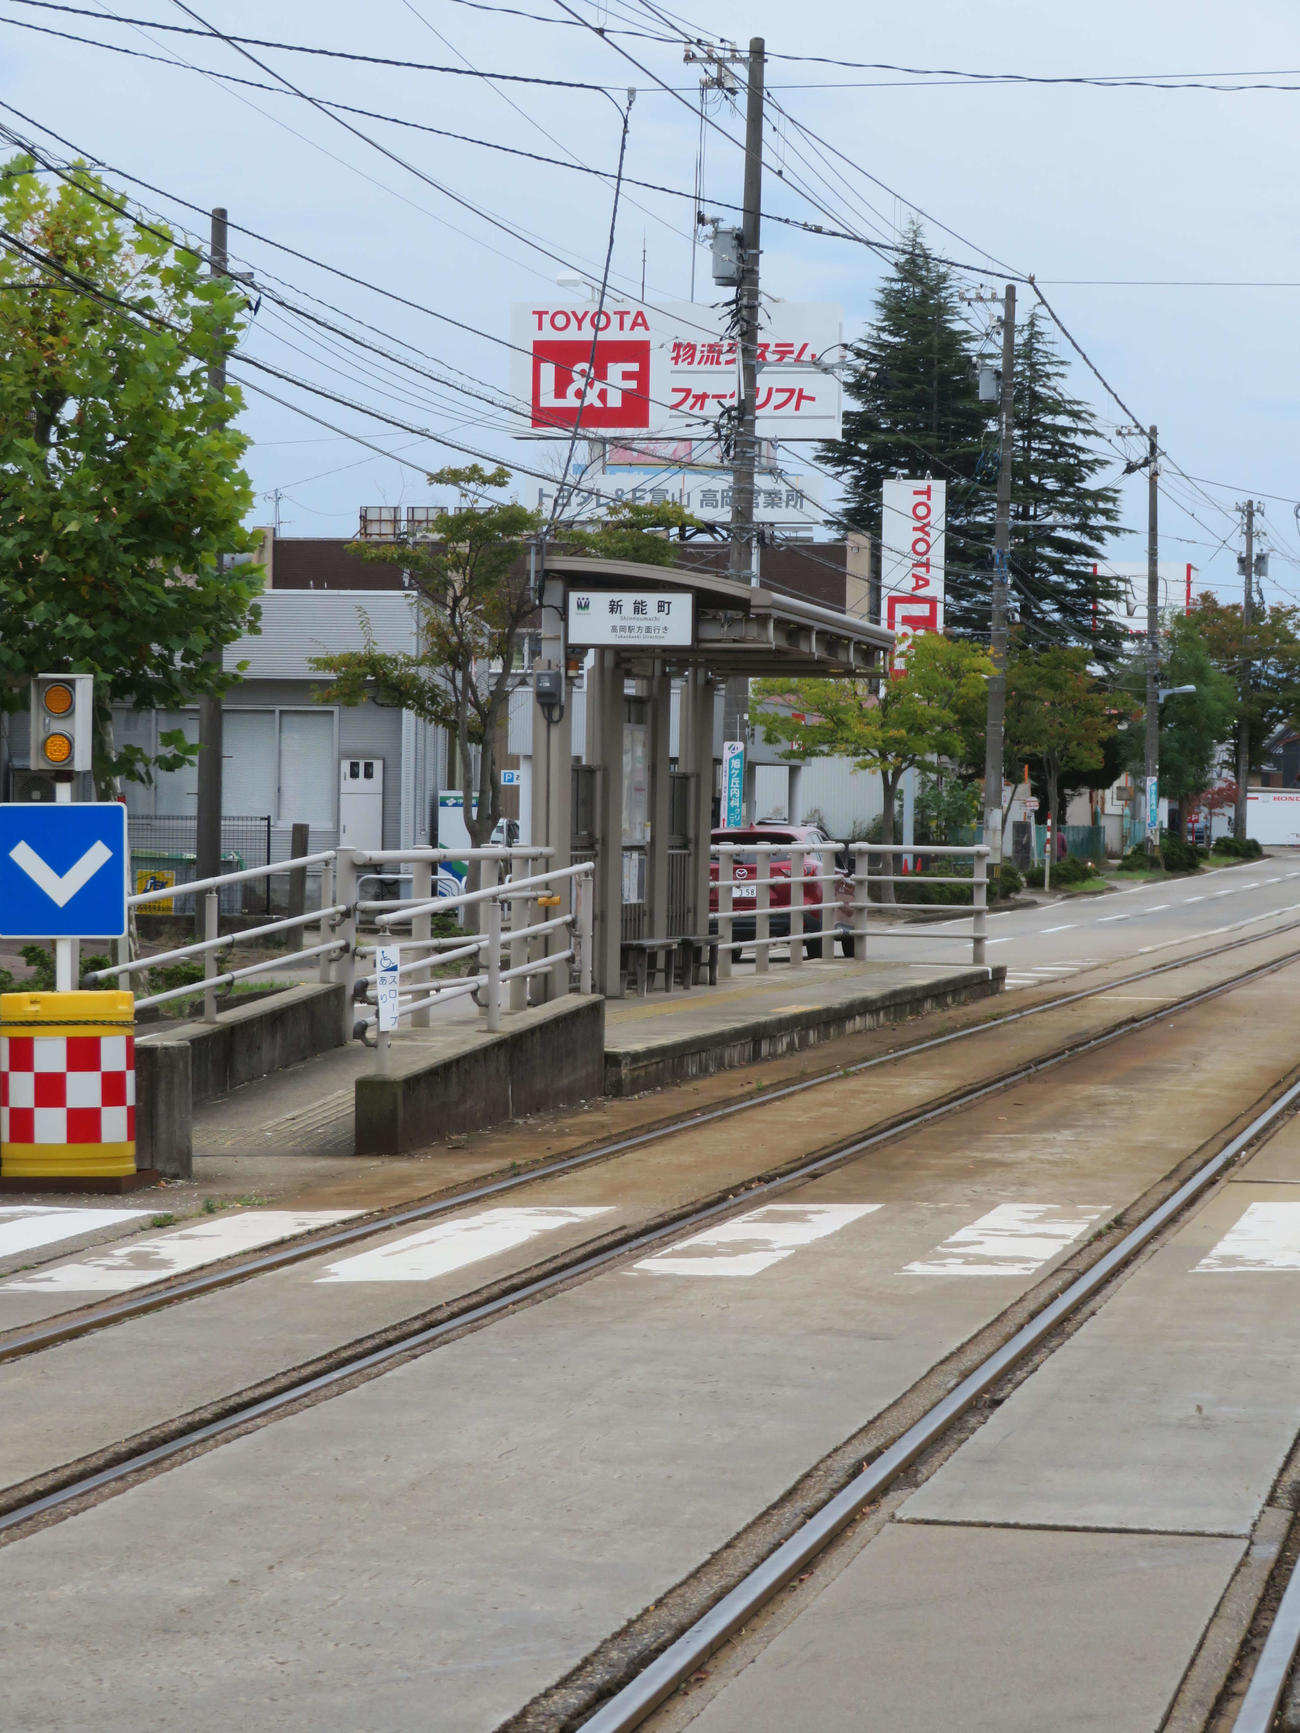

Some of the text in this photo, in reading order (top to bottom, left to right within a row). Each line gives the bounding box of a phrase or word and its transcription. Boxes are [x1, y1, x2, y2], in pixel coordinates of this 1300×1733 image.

[532, 310, 650, 332] TOYOTA
[539, 362, 640, 408] L&F
[670, 387, 816, 411] フォーリフト
[911, 485, 932, 592] TOYOTA
[608, 599, 672, 616] 新能町
[610, 625, 669, 634] 高岡駅方面行き
[378, 976, 388, 1004] あり
